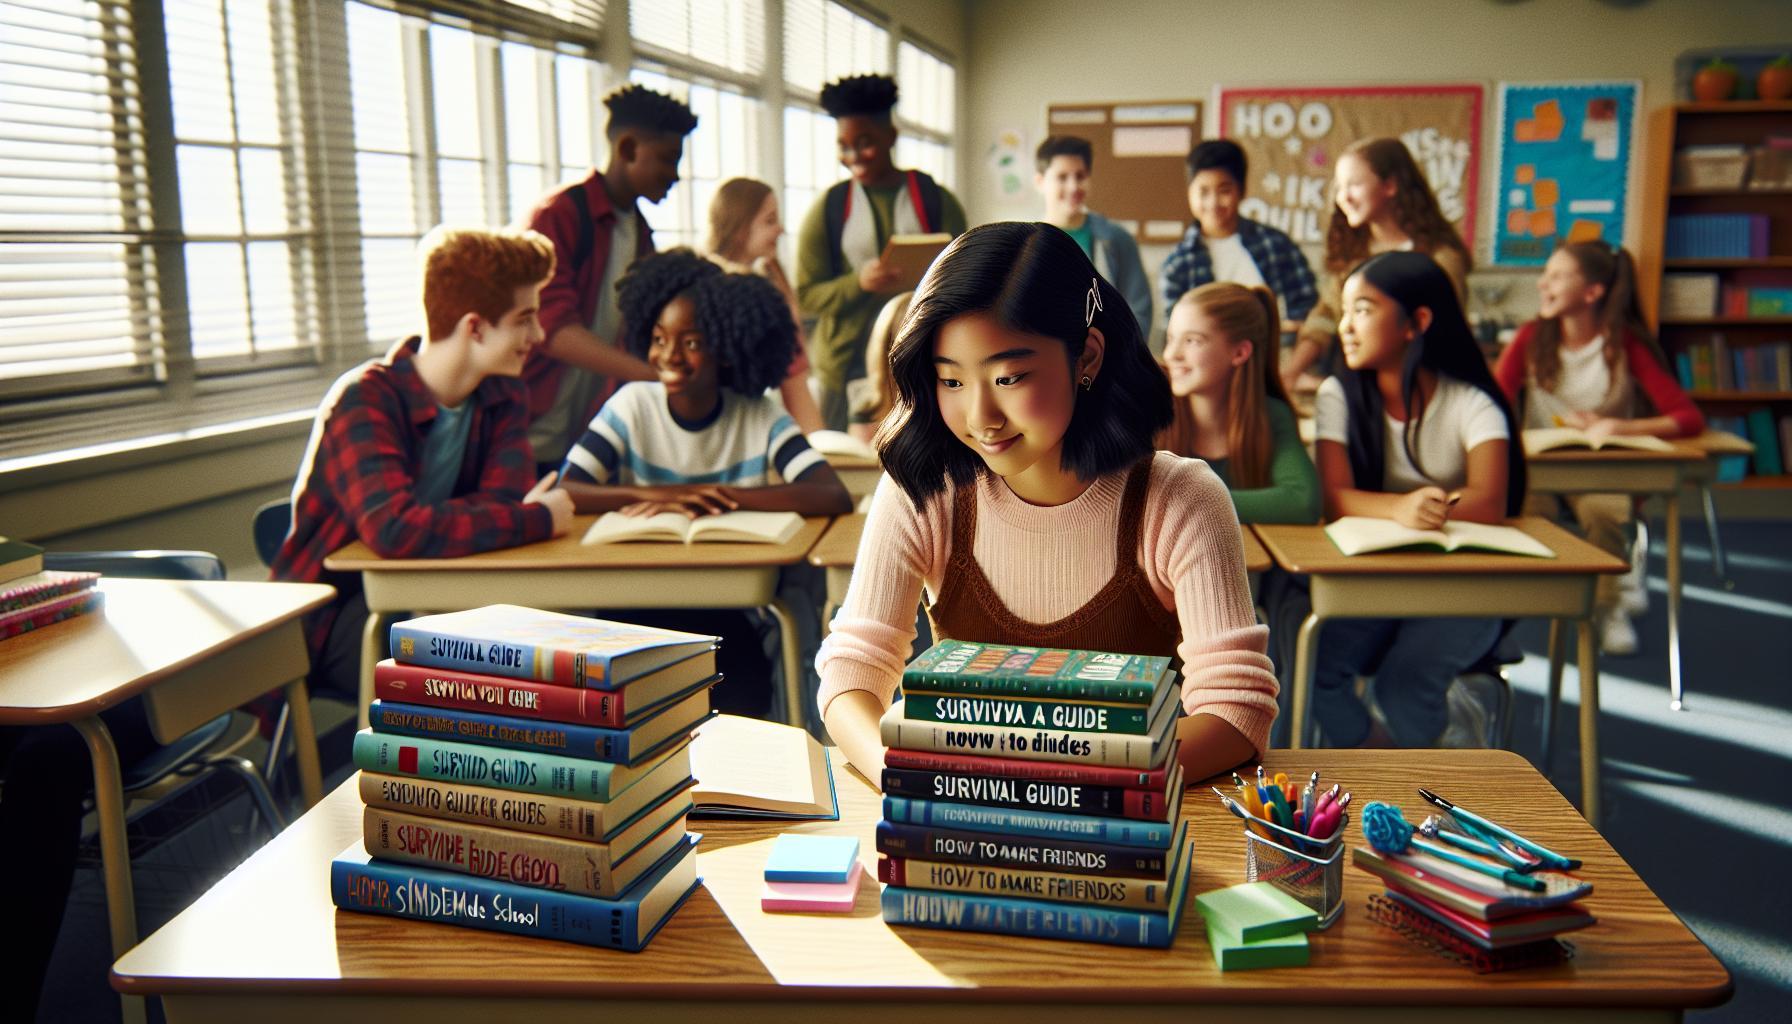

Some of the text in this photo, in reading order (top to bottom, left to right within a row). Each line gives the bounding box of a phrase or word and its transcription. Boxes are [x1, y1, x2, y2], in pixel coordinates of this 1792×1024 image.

[1032, 704, 1046, 726] A
[1052, 705, 1109, 730] GUIDE
[933, 775, 1082, 808] SURVIVAL GUIDE
[979, 842, 998, 859] TO
[930, 866, 975, 888] HOW
[978, 870, 997, 890] TO
